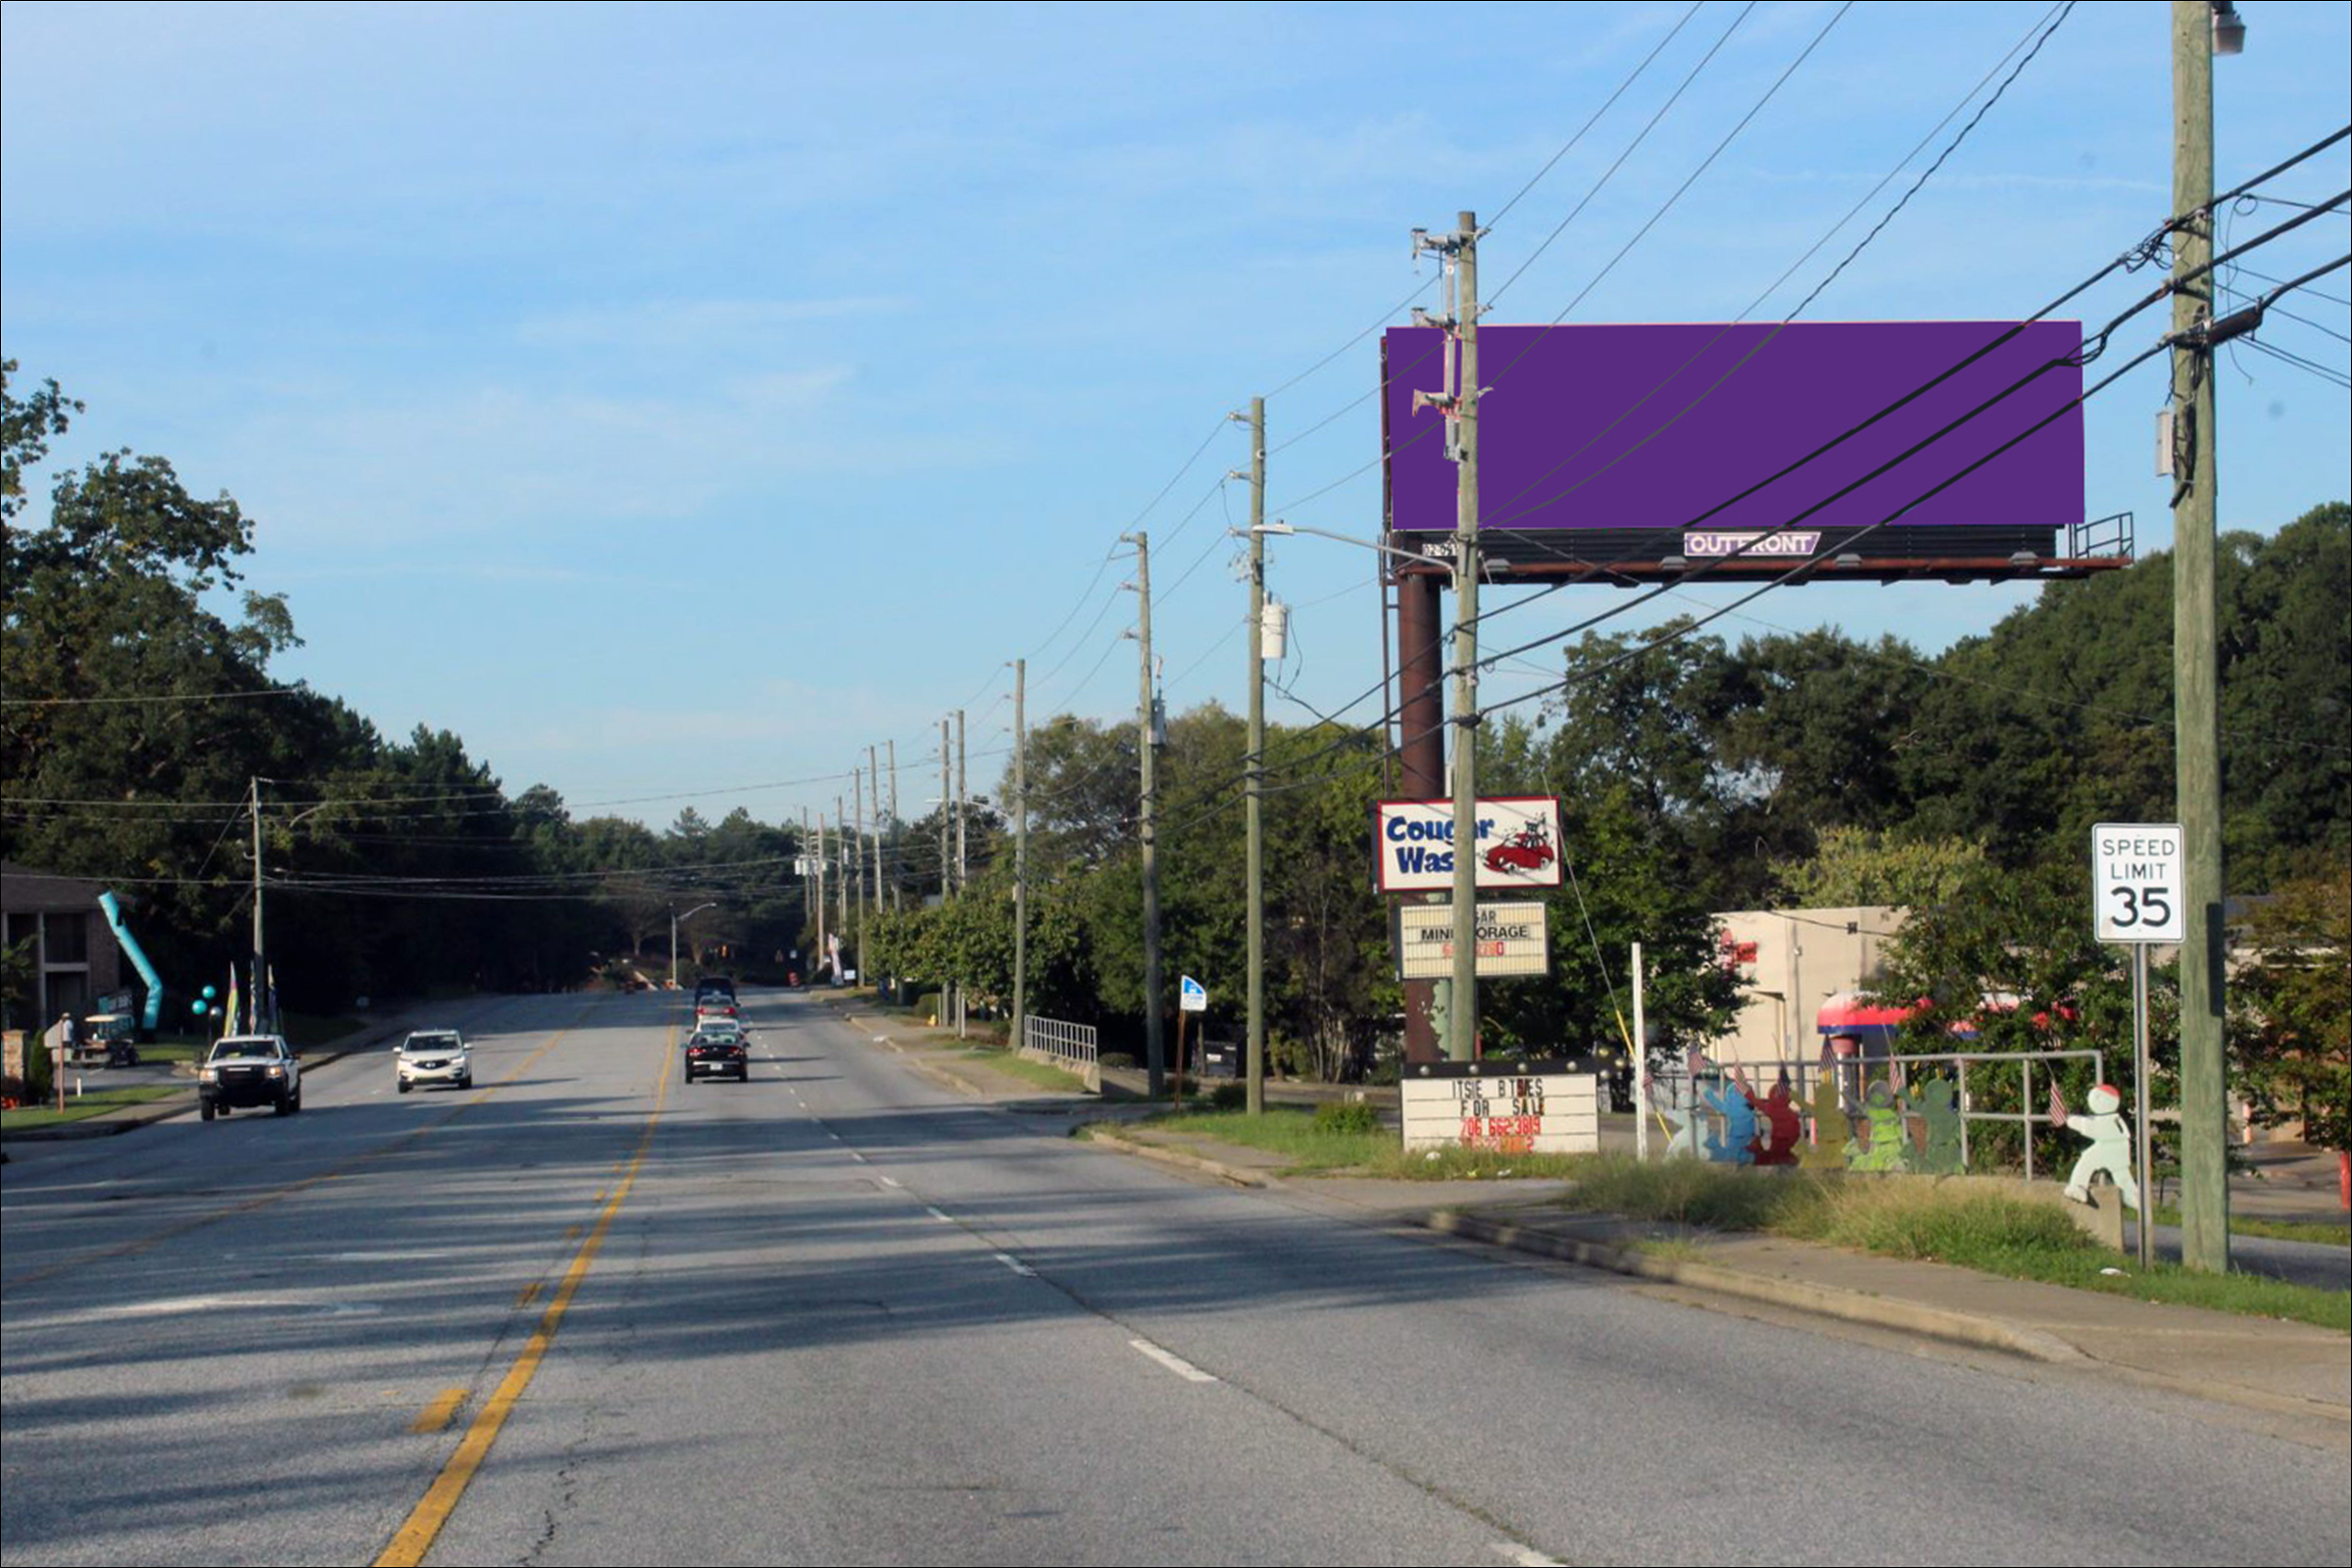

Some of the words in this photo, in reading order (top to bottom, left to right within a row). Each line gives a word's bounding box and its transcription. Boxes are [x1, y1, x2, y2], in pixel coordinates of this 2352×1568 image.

[1386, 815, 1494, 846] Cour
[2102, 838, 2176, 857] SPEED
[1396, 846, 1456, 874] Was
[2111, 862, 2167, 880] LIMIT
[2110, 885, 2172, 928] 35
[1475, 925, 1528, 940] ORAGE
